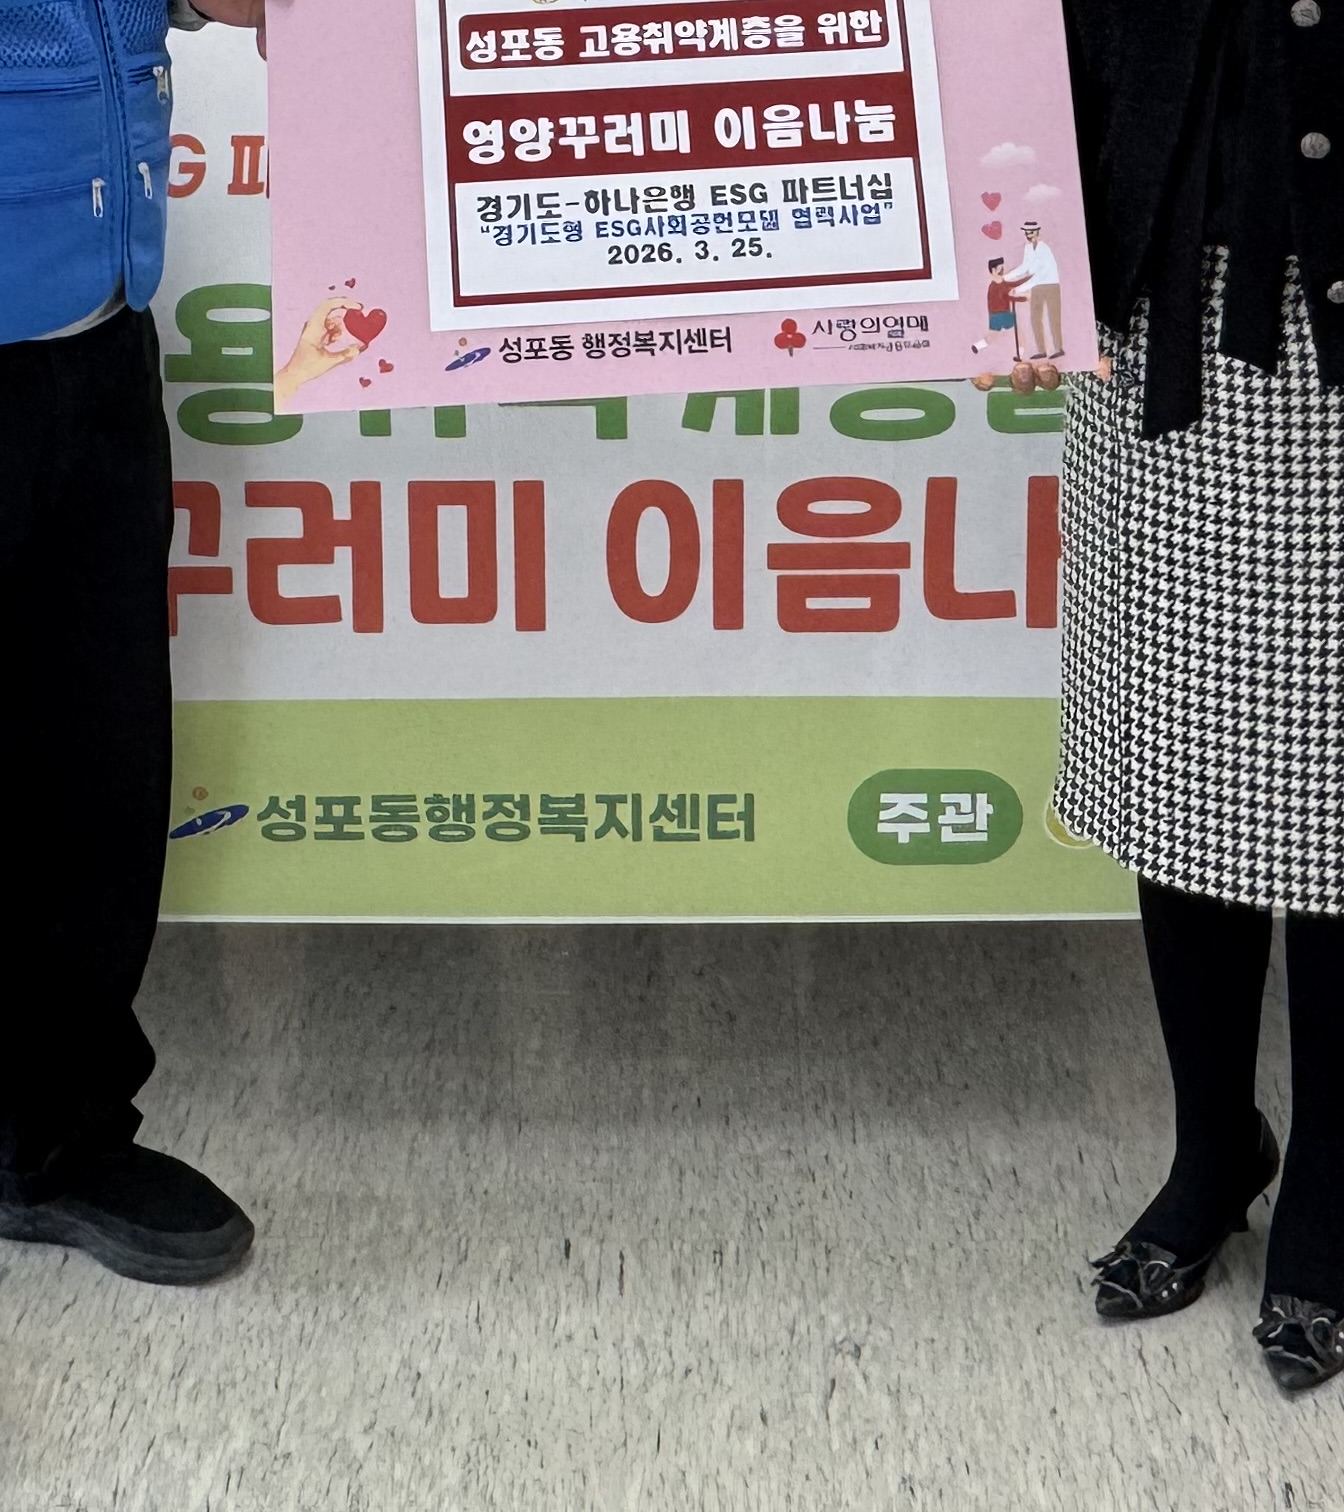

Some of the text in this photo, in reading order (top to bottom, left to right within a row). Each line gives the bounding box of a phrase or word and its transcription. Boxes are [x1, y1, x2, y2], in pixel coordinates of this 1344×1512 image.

[465, 9, 883, 64] 성포동 고용취약계층을 위한
[462, 99, 897, 165] 영양꾸러미 이음나눔
[476, 172, 894, 223] 경기도-하나은행 ESG 파트너십
[607, 237, 774, 265] 2026. 3. 25.
[498, 326, 733, 364] 성포동 행정복지센터
[256, 792, 758, 844] 성포동행정복지센터
[874, 791, 996, 845] 주관
